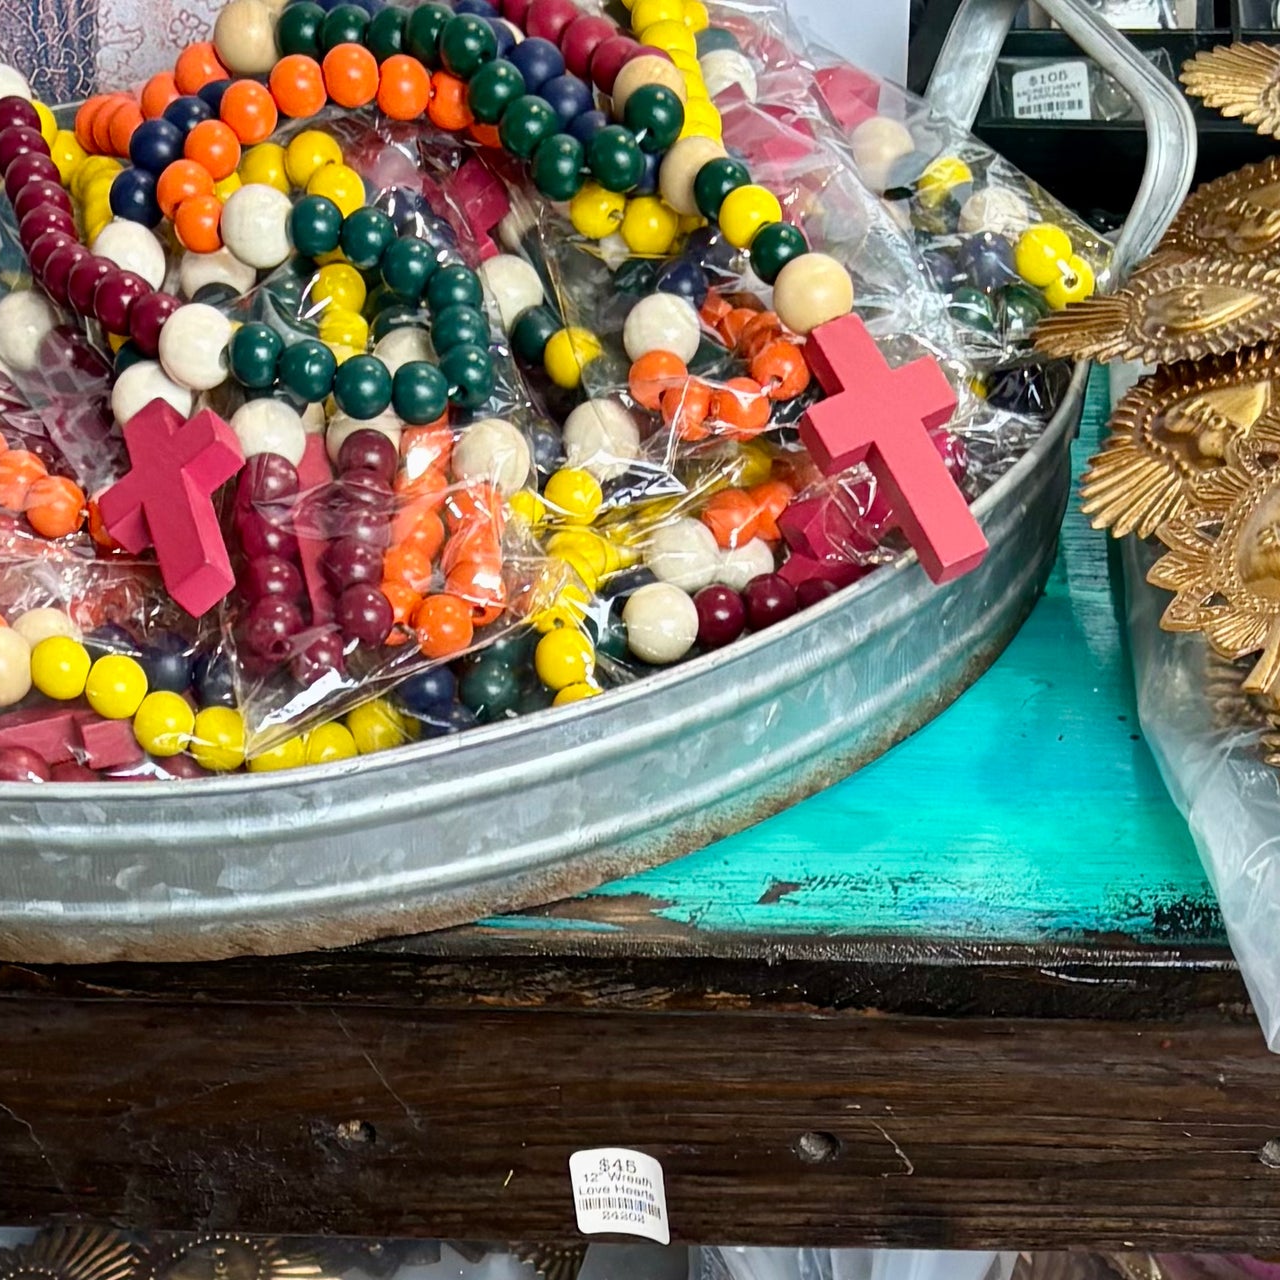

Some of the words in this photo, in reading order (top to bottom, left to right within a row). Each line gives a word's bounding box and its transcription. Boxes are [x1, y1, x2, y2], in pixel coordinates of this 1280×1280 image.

[599, 1157, 637, 1174] $45
[607, 1171, 653, 1190] Wreath
[578, 1185, 610, 1196] Love
[614, 1184, 655, 1202] Hearts
